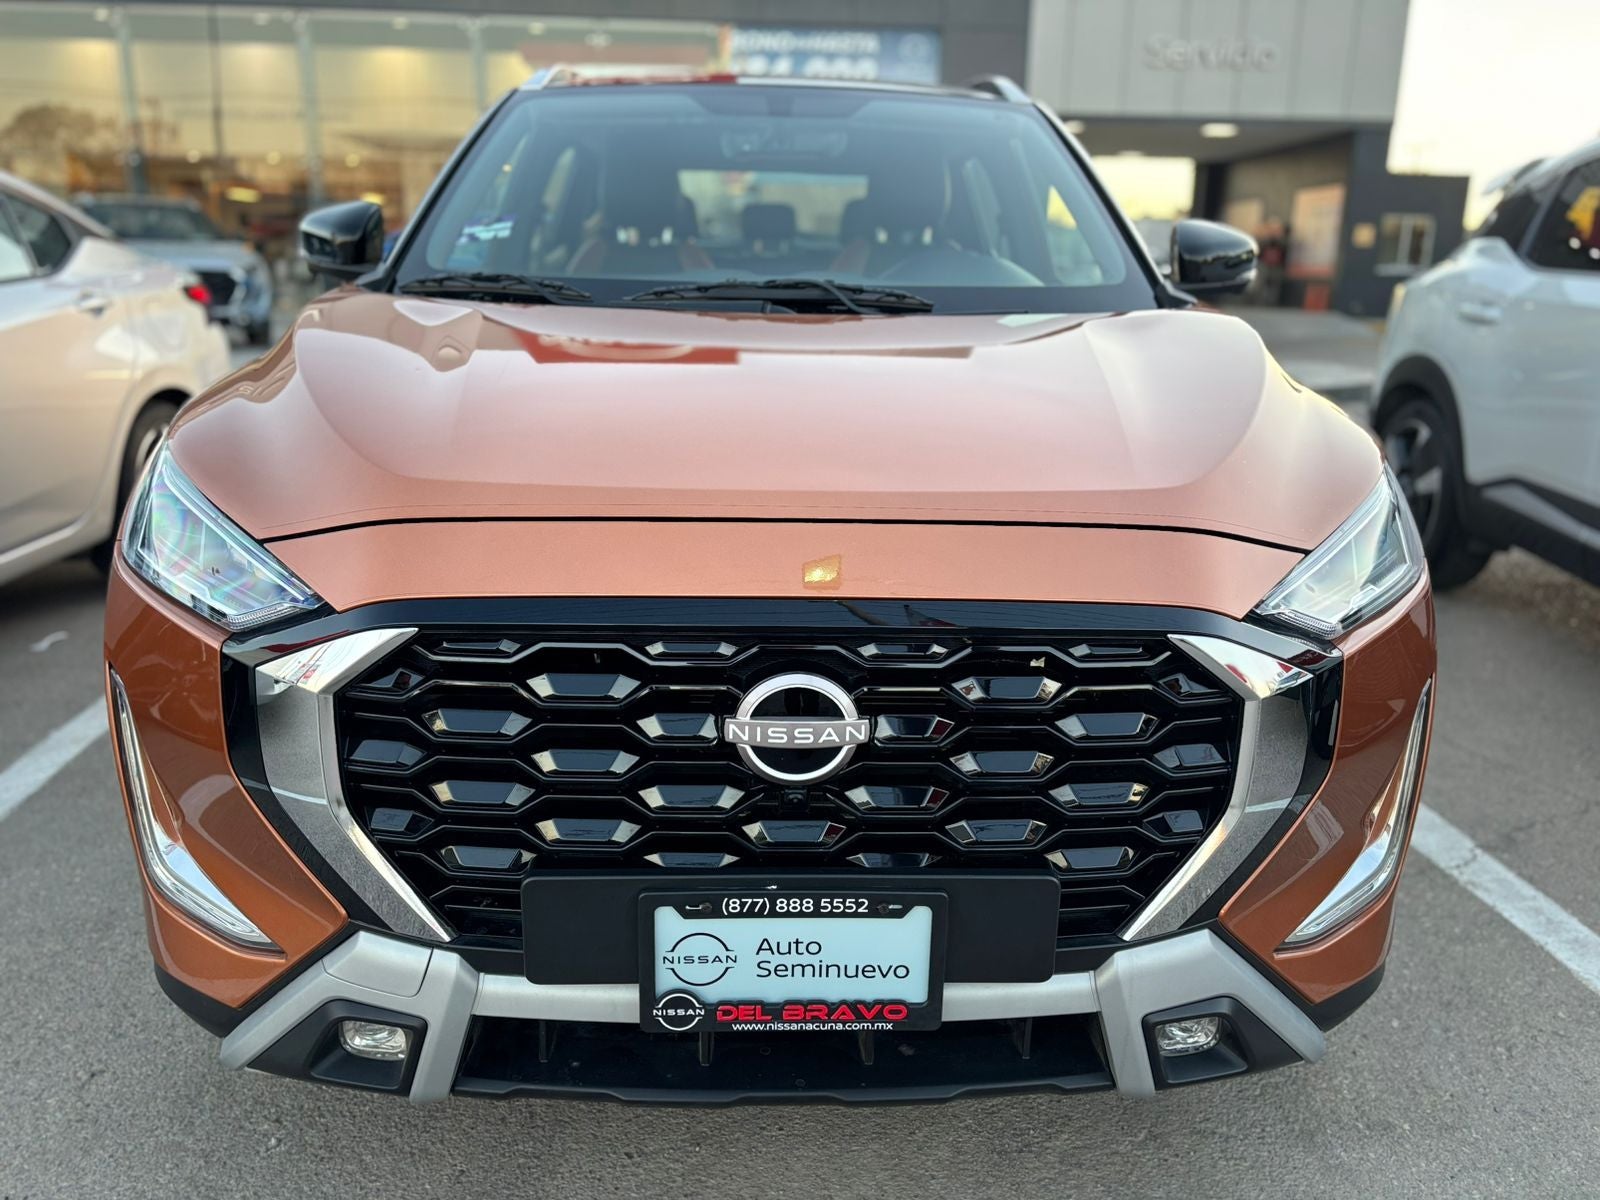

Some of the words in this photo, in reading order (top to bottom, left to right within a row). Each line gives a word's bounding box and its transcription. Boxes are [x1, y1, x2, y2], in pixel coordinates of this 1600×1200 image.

[1143, 35, 1279, 72] Servicio
[728, 723, 866, 744] NISSAN
[722, 897, 770, 916] (877)
[775, 898, 814, 913] 888
[820, 898, 869, 913] 5552
[755, 937, 822, 956] Auto
[662, 954, 738, 965] NISSAN
[755, 959, 910, 980] Seminuevo
[652, 1008, 705, 1016] NISSAN
[716, 1004, 772, 1022] DEL
[782, 1004, 908, 1021] BRAVO
[731, 1020, 894, 1032] www.nissanacuna.com.mx
